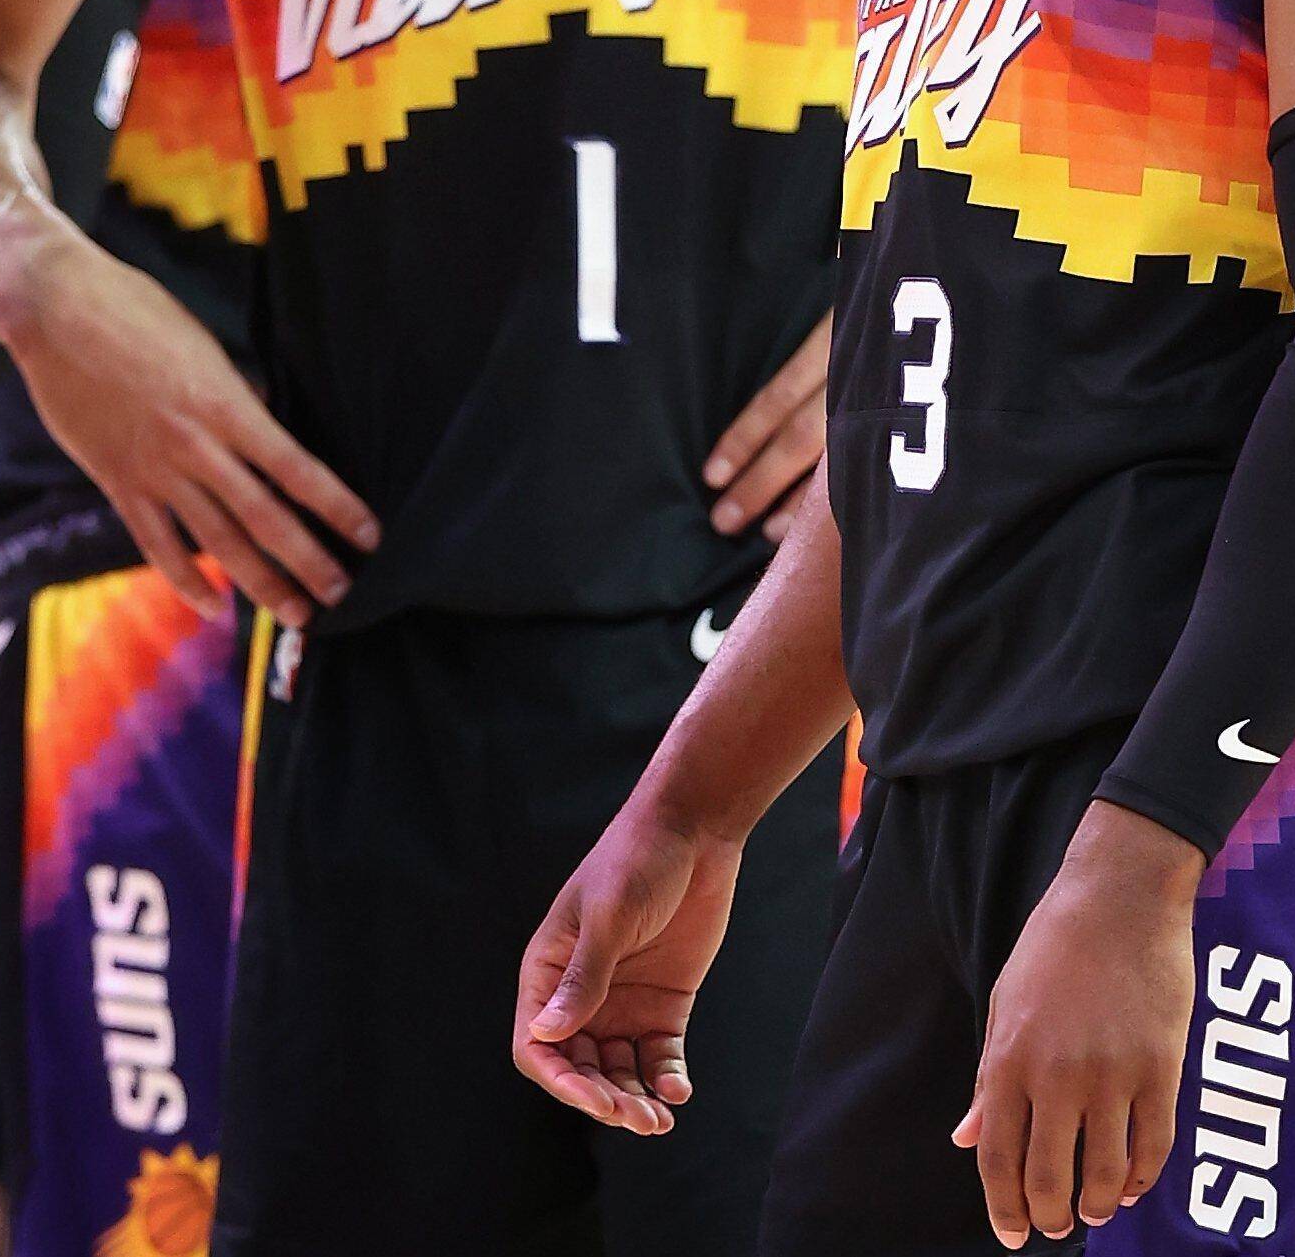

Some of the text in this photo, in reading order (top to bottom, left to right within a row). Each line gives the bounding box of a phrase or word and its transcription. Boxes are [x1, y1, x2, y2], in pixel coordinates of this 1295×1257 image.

[572, 140, 622, 343] 1
[888, 276, 953, 494] 3
[85, 863, 189, 1135] SUNS
[1188, 945, 1293, 1240] SUNS
